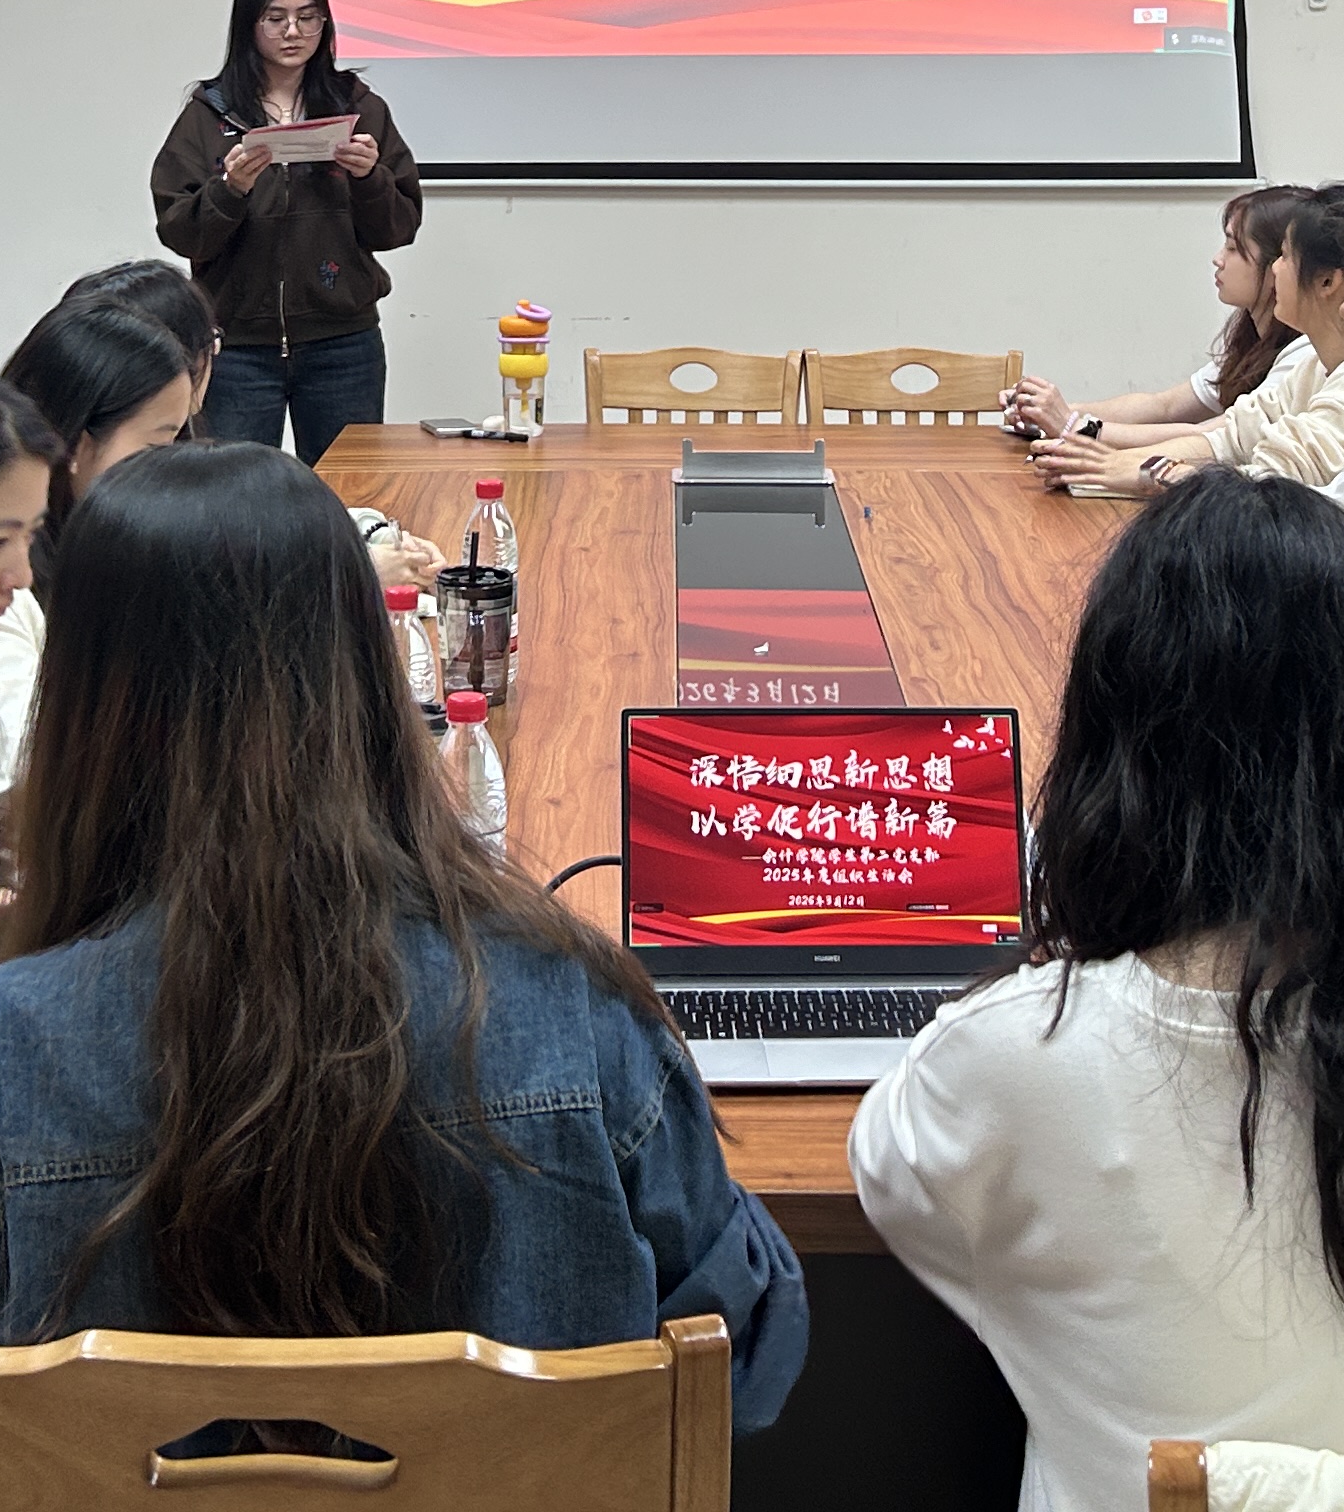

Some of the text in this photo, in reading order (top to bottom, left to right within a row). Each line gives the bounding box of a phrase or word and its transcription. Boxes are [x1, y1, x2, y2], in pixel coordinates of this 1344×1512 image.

[689, 749, 955, 792] 深悟细思新思想
[689, 798, 958, 841] 以学促行谱新篇
[762, 867, 914, 886] 2025年度组织生活会
[788, 894, 865, 908] 2026年3月12日
[814, 954, 842, 963] HUAWEI
